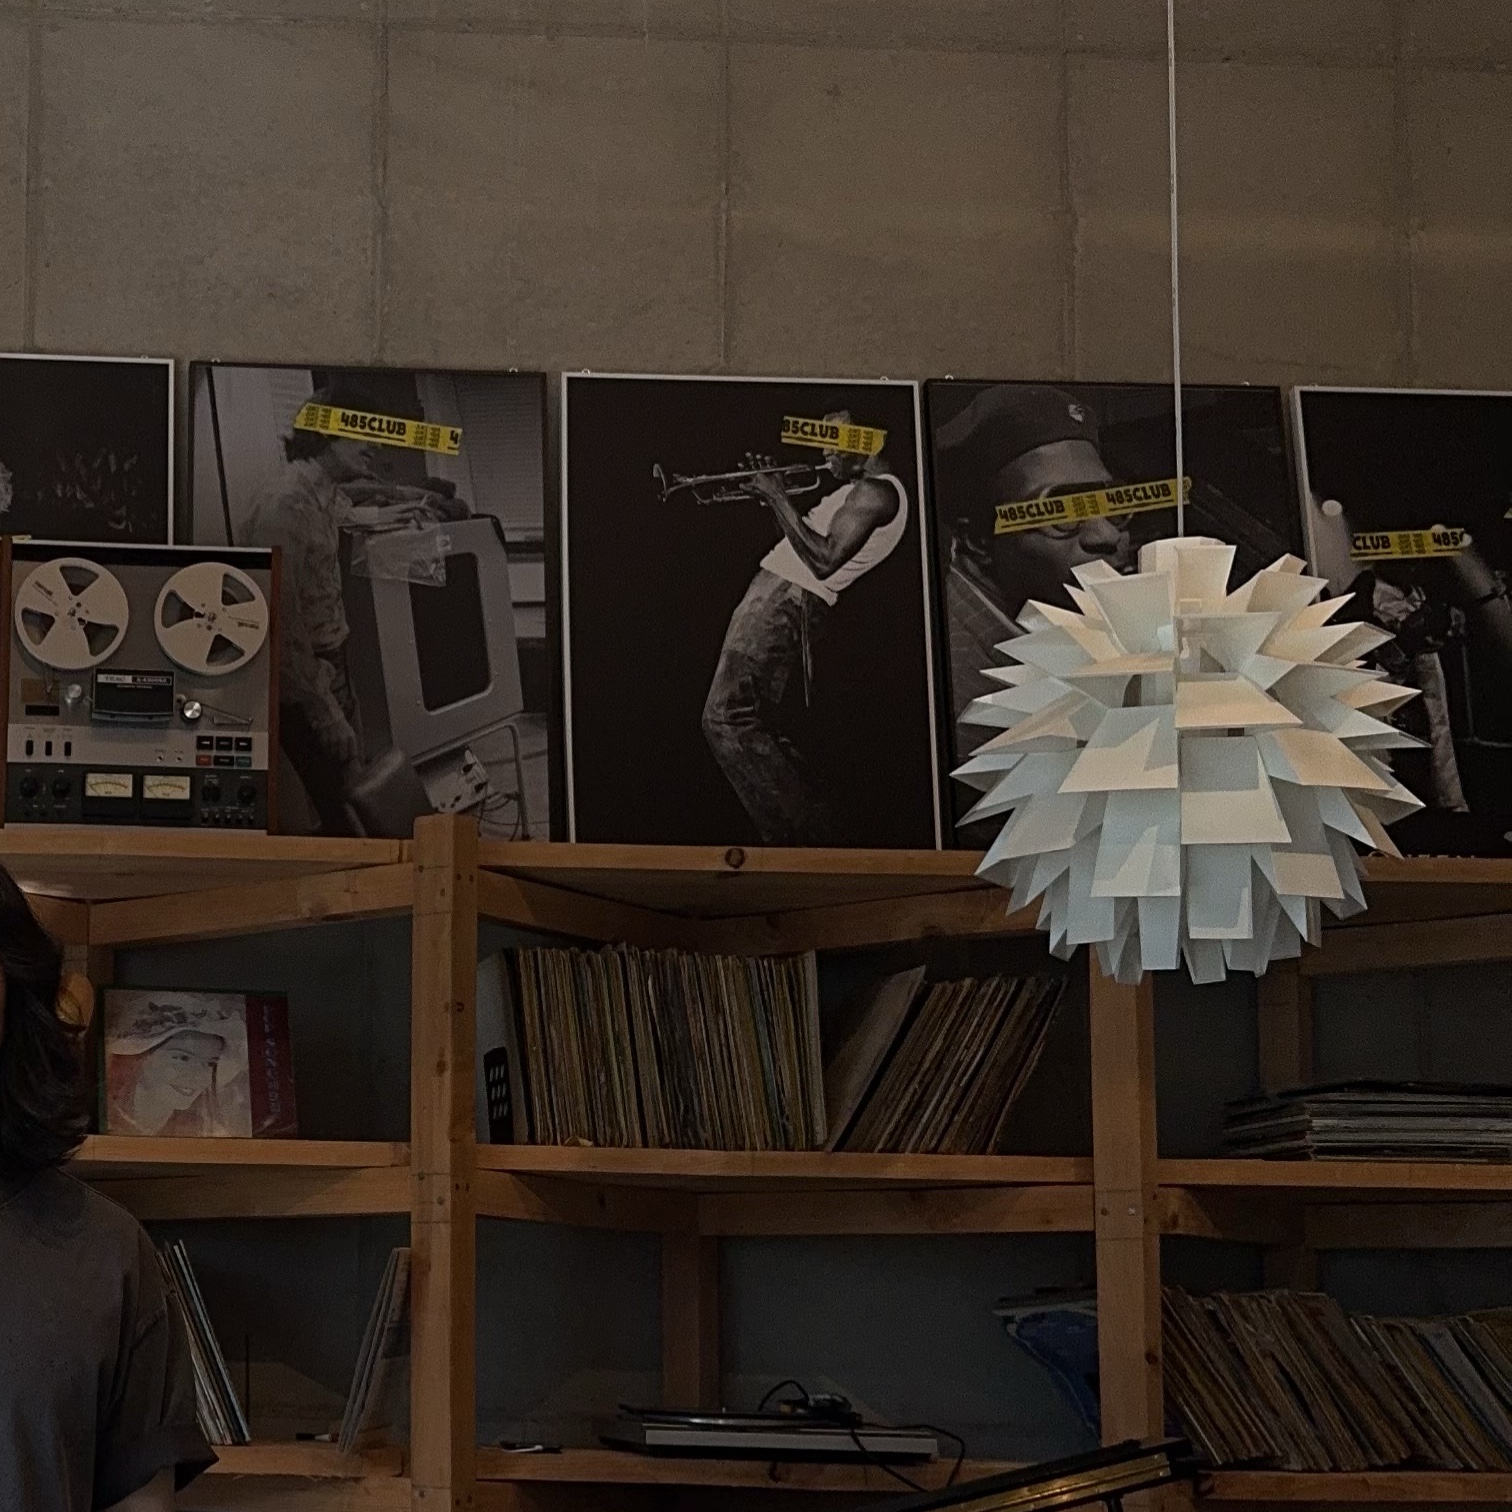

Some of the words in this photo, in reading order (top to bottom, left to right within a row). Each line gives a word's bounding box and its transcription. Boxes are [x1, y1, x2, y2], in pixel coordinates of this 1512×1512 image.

[341, 412, 406, 436] 485CLUB
[1106, 483, 1172, 505] 485CLUB
[998, 500, 1065, 522] 485CLUB
[1352, 535, 1391, 551] CLUB
